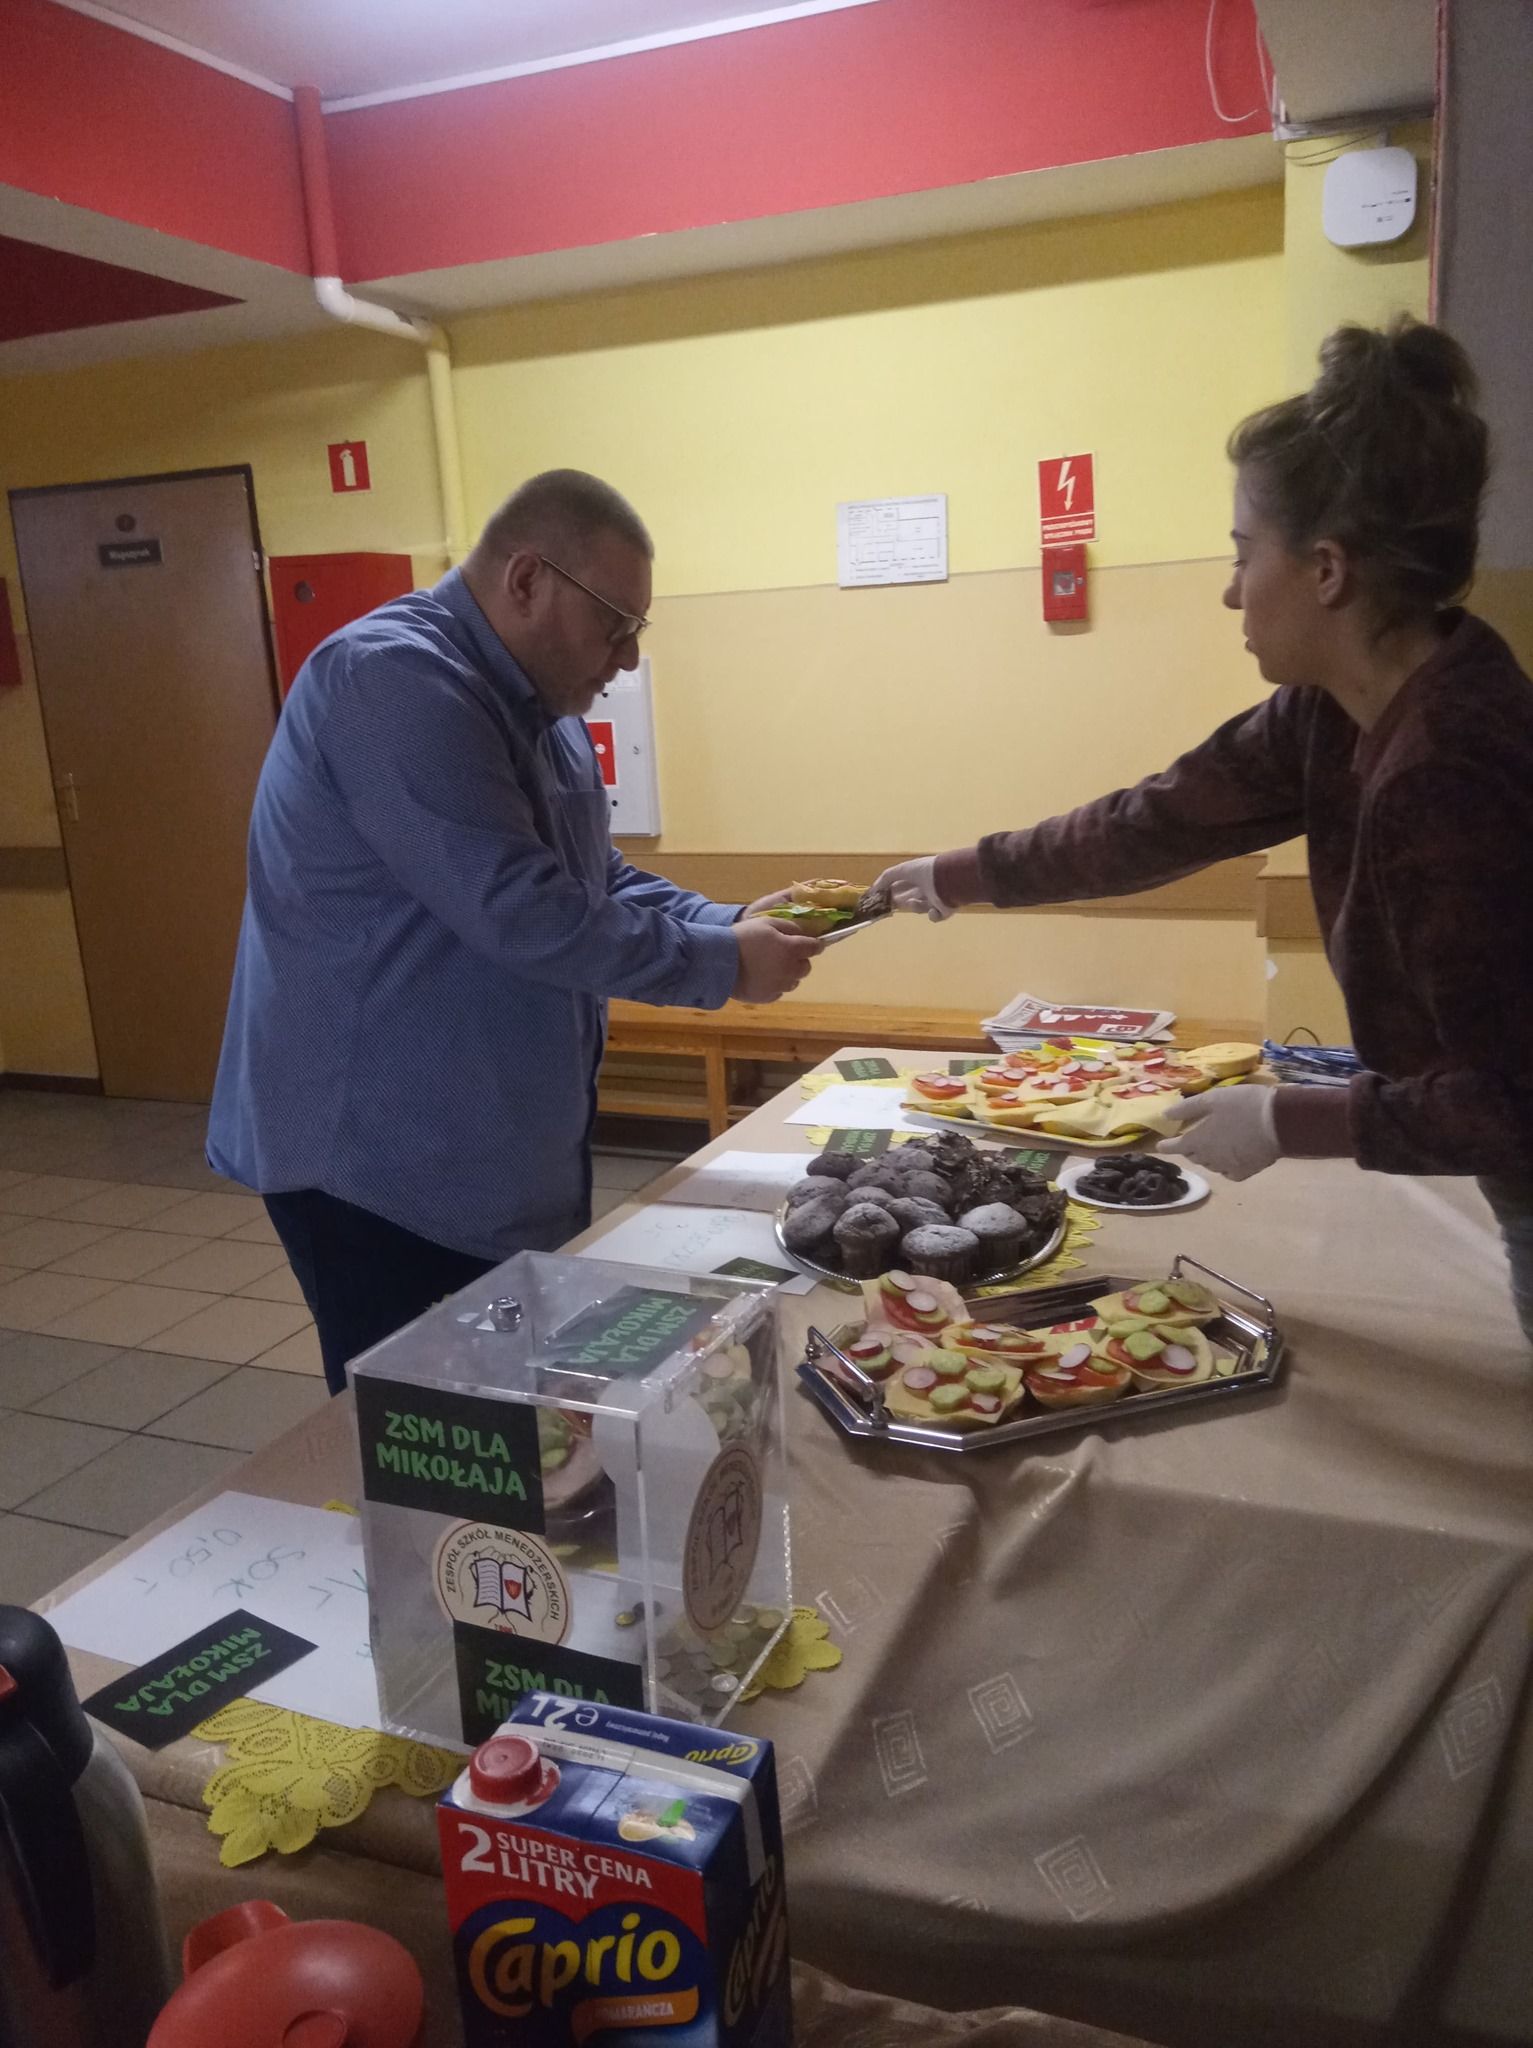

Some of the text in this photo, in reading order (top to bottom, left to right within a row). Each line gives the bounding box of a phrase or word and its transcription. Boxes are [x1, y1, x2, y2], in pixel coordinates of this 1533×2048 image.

[567, 1297, 673, 1363] MIKOŁAJA
[607, 1306, 697, 1363] ZSM DLA
[385, 1411, 510, 1462] ZSM DLA
[376, 1441, 528, 1501] MIKOŁAJA
[446, 1546, 464, 1593] ZESPÓŁ
[457, 1528, 492, 1550] SZKÓŁ
[115, 1627, 263, 1713] MIKOŁAJA
[146, 1643, 273, 1717] ZSM DLA
[485, 1659, 546, 1691] ZSM
[458, 1823, 600, 1899] 2 LITRY
[497, 1832, 653, 1889] SUPER CENA
[468, 1912, 681, 2018] Caprio
